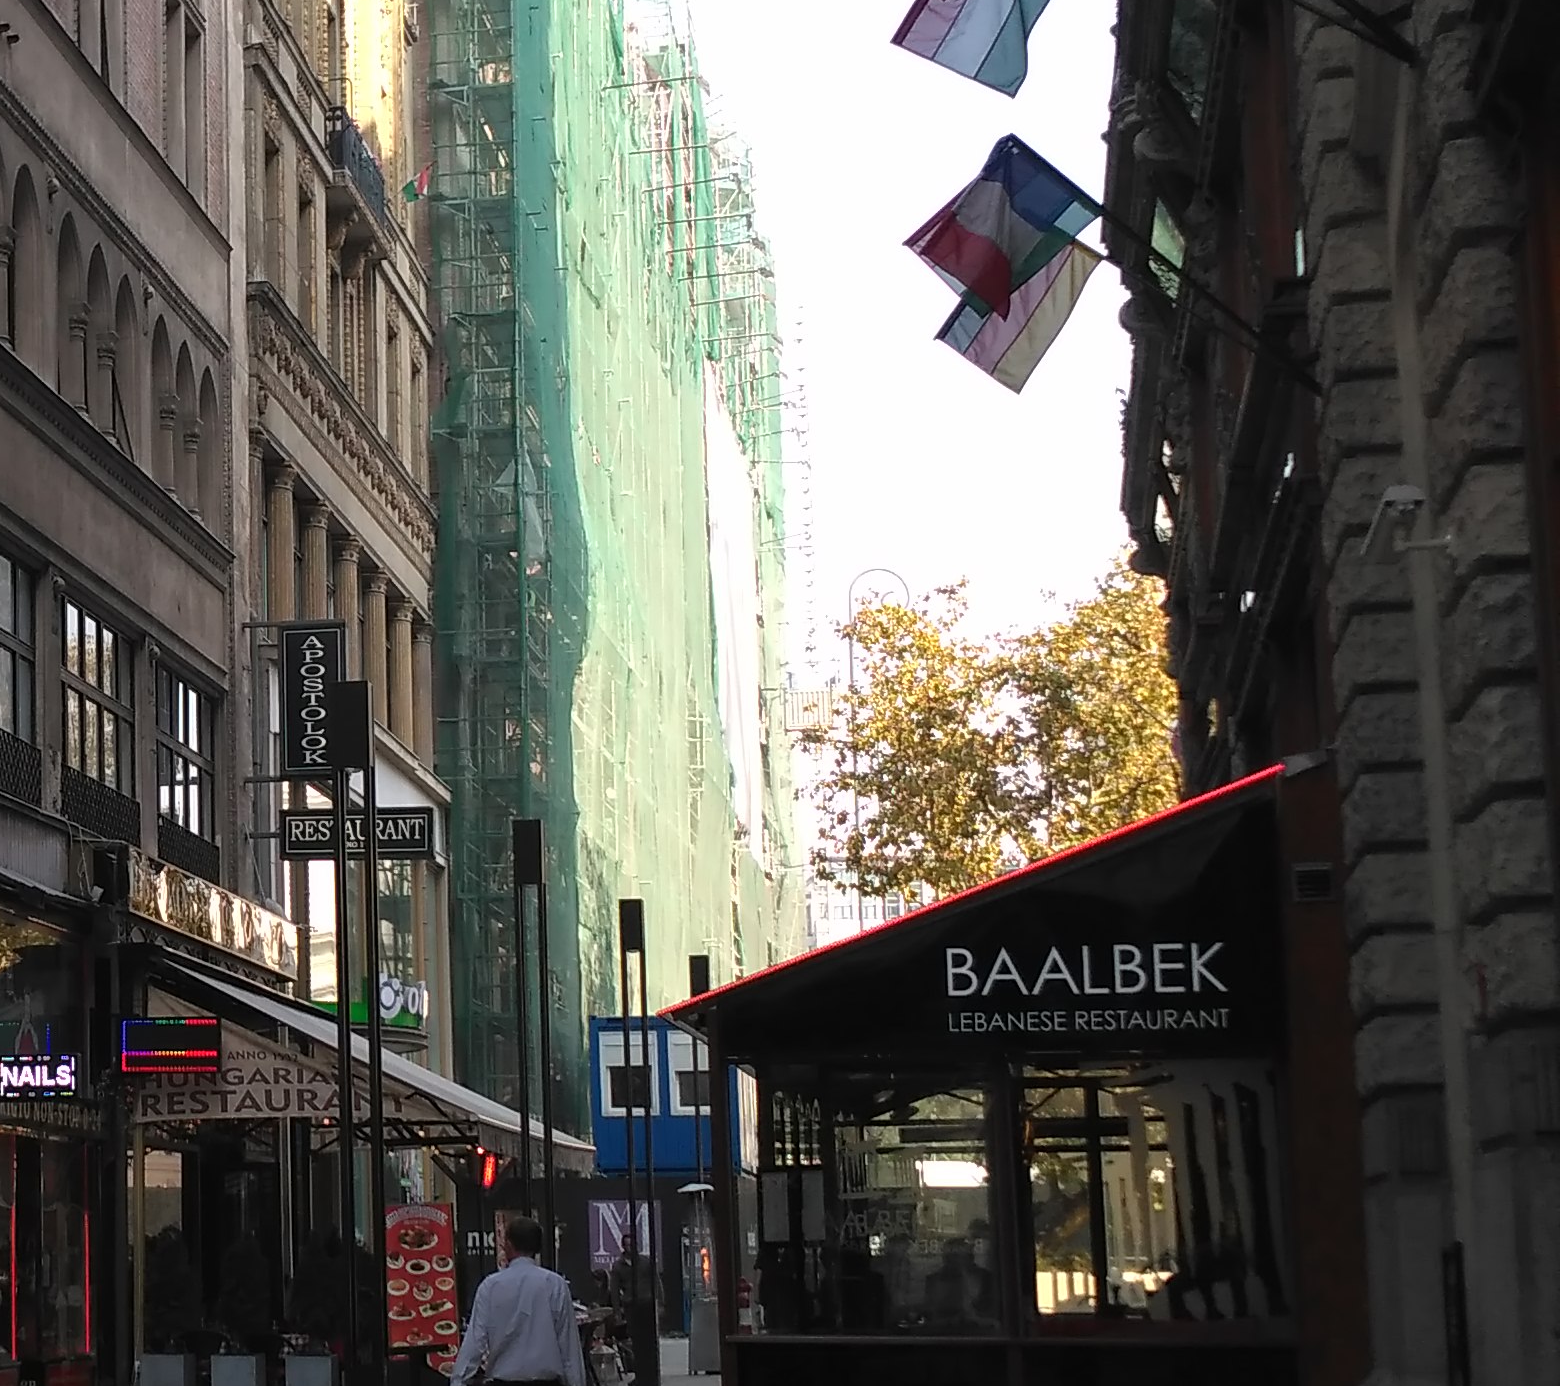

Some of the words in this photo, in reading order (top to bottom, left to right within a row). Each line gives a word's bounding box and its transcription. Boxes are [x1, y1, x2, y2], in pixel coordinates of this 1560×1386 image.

[300, 635, 327, 764] APOSTOLOK
[290, 819, 423, 841] RESAURANT
[945, 942, 1228, 996] BAALBEK
[948, 1011, 1067, 1032] LEBANESE
[1075, 1009, 1229, 1030] RESTAURANT
[227, 1050, 267, 1061] ANNO
[1, 1064, 71, 1087] NAILS
[141, 1067, 339, 1089] HUNGARIA
